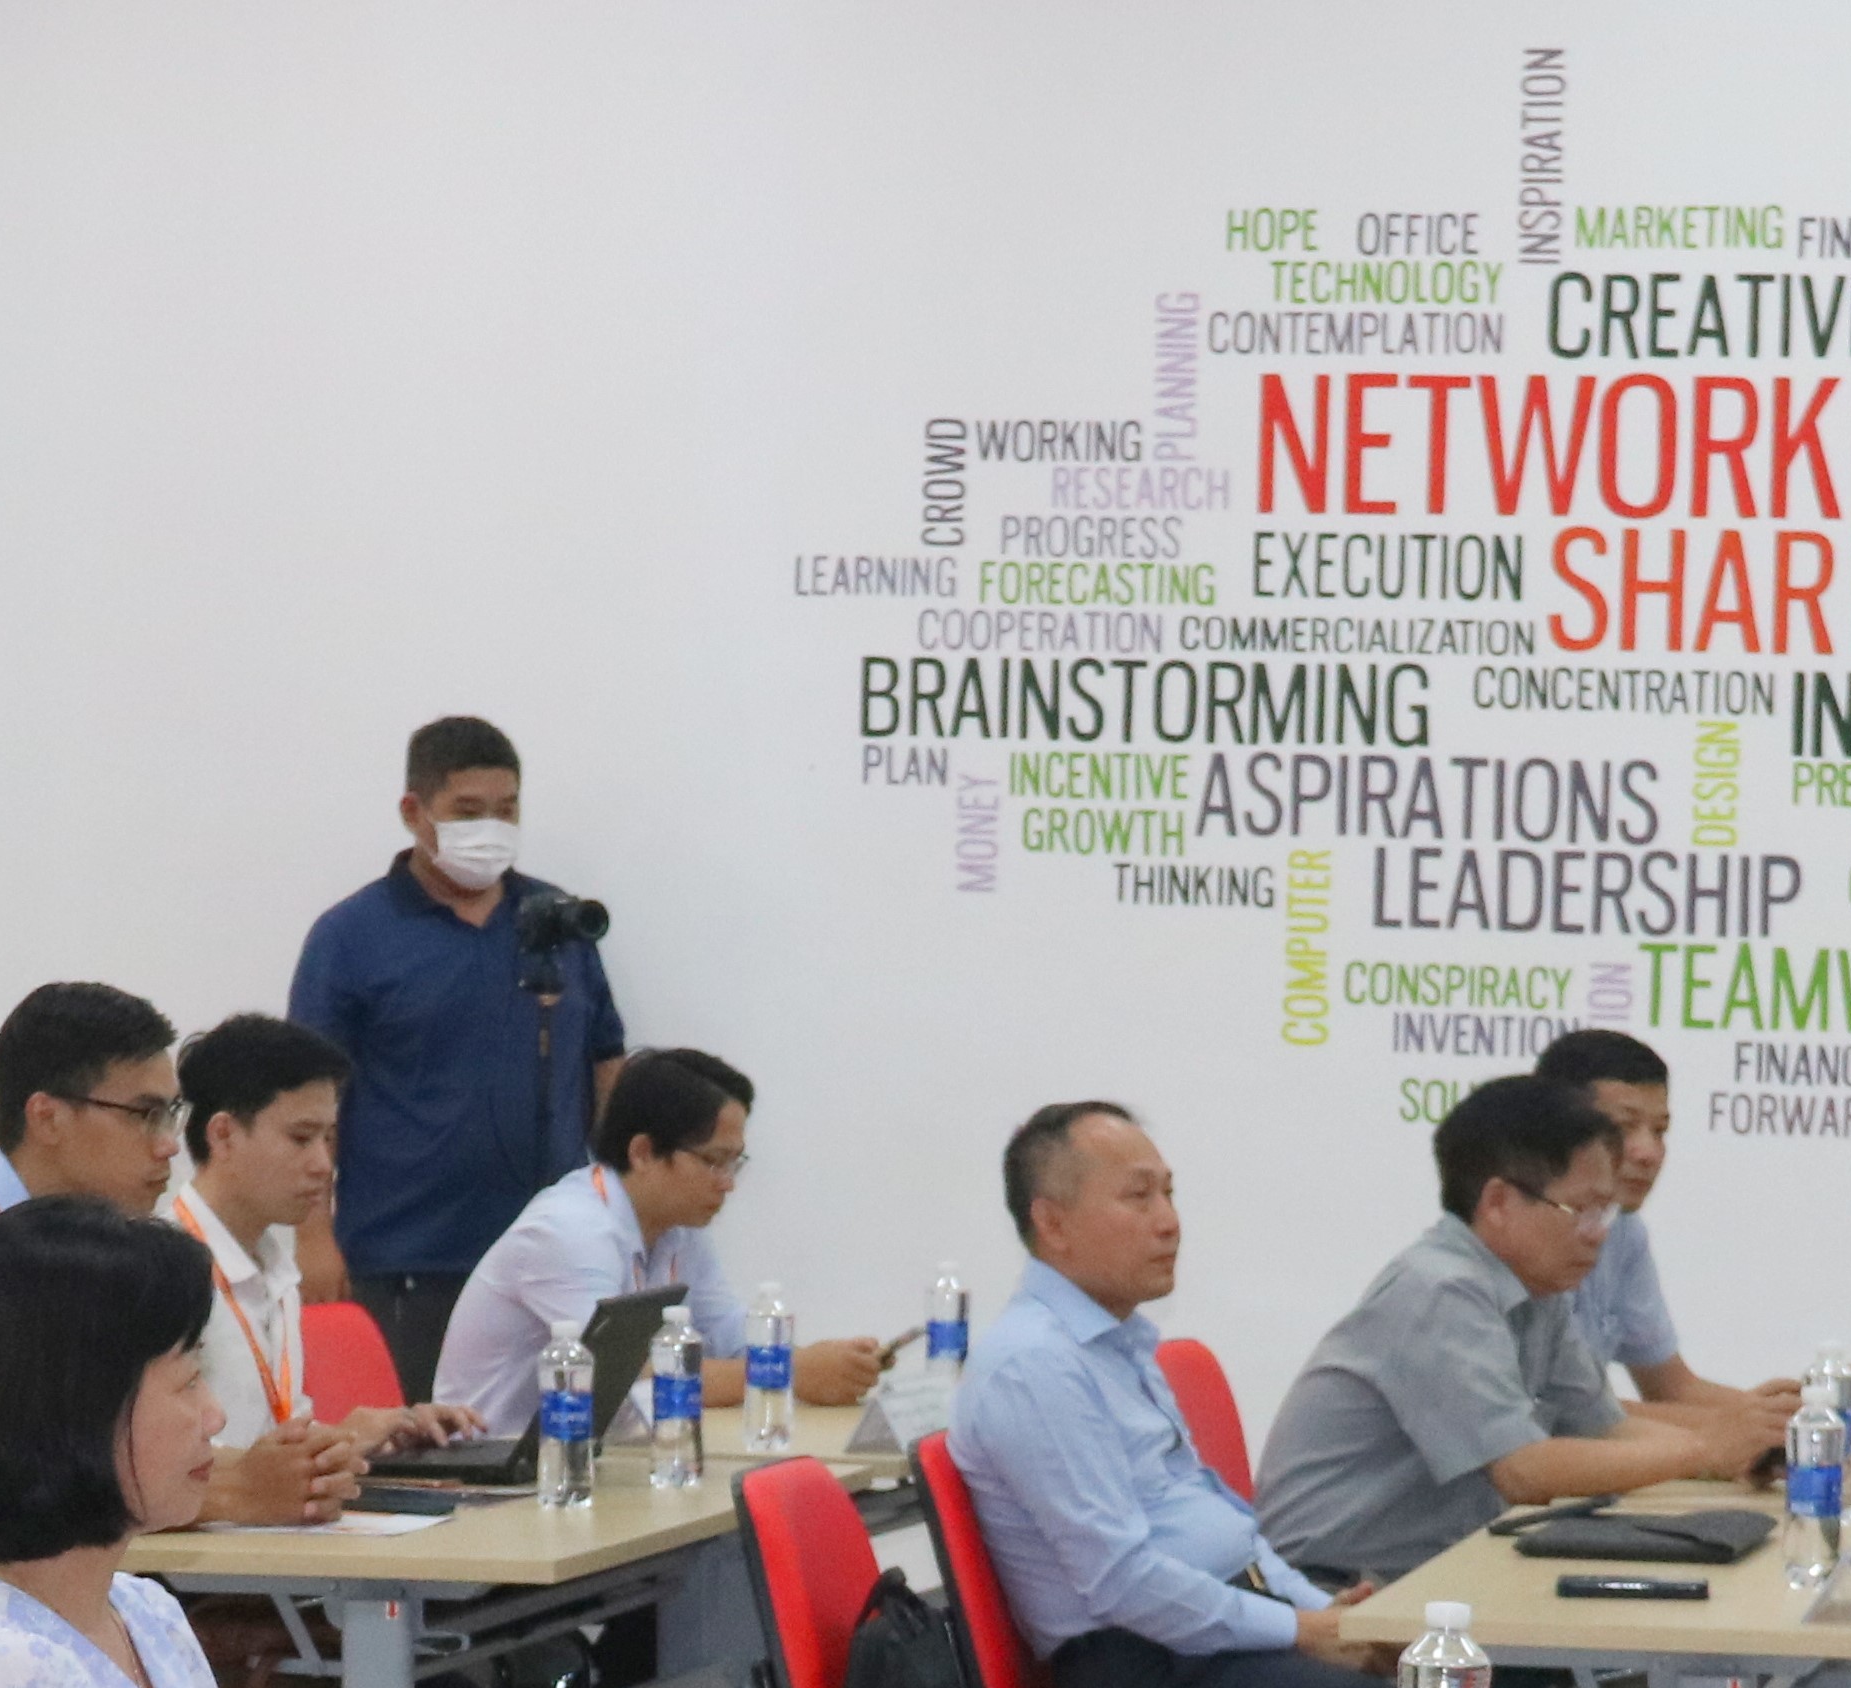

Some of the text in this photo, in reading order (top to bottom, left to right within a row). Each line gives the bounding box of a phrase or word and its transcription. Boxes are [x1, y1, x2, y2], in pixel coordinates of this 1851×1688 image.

[1518, 48, 1566, 265] INSPIRATION
[1226, 207, 1319, 253] HOPE
[1357, 212, 1479, 257] OFFICE
[1575, 204, 1784, 250] MARKETING
[1270, 259, 1502, 305] TECHNOLOGY
[1209, 311, 1503, 355] CONTEMPLATION
[1155, 291, 1199, 461] PLANNING
[976, 419, 1142, 463] WORKING
[1256, 372, 1843, 521] NETWORK
[921, 418, 968, 547] CROWD
[1052, 468, 1229, 510] RESEARCH
[1002, 515, 1181, 559] PROGRESS
[795, 556, 956, 597] LEARNING
[980, 560, 1216, 607] FORECASTING
[1253, 530, 1524, 603] EXECUTION
[1547, 525, 1836, 656] SHAR
[919, 609, 1162, 653] COOPERATION
[1179, 615, 1536, 657] COMMERCIALIZATION
[859, 655, 1430, 749] BRAINSTORMING
[1473, 665, 1775, 716] CONCENTRATION
[863, 744, 948, 786] PLAN
[1009, 751, 1190, 801] INCENTIVE
[1691, 720, 1741, 847] DESIGN
[1195, 750, 1660, 847] ASPIRATIONS
[956, 774, 998, 895] MONEY
[1022, 807, 1185, 857] GROWTH
[1113, 862, 1275, 909] THINKING
[1372, 846, 1803, 939] LEADERSHIP
[1281, 849, 1332, 1047] COMPUTER
[1344, 960, 1572, 1011] CONSPIRACY
